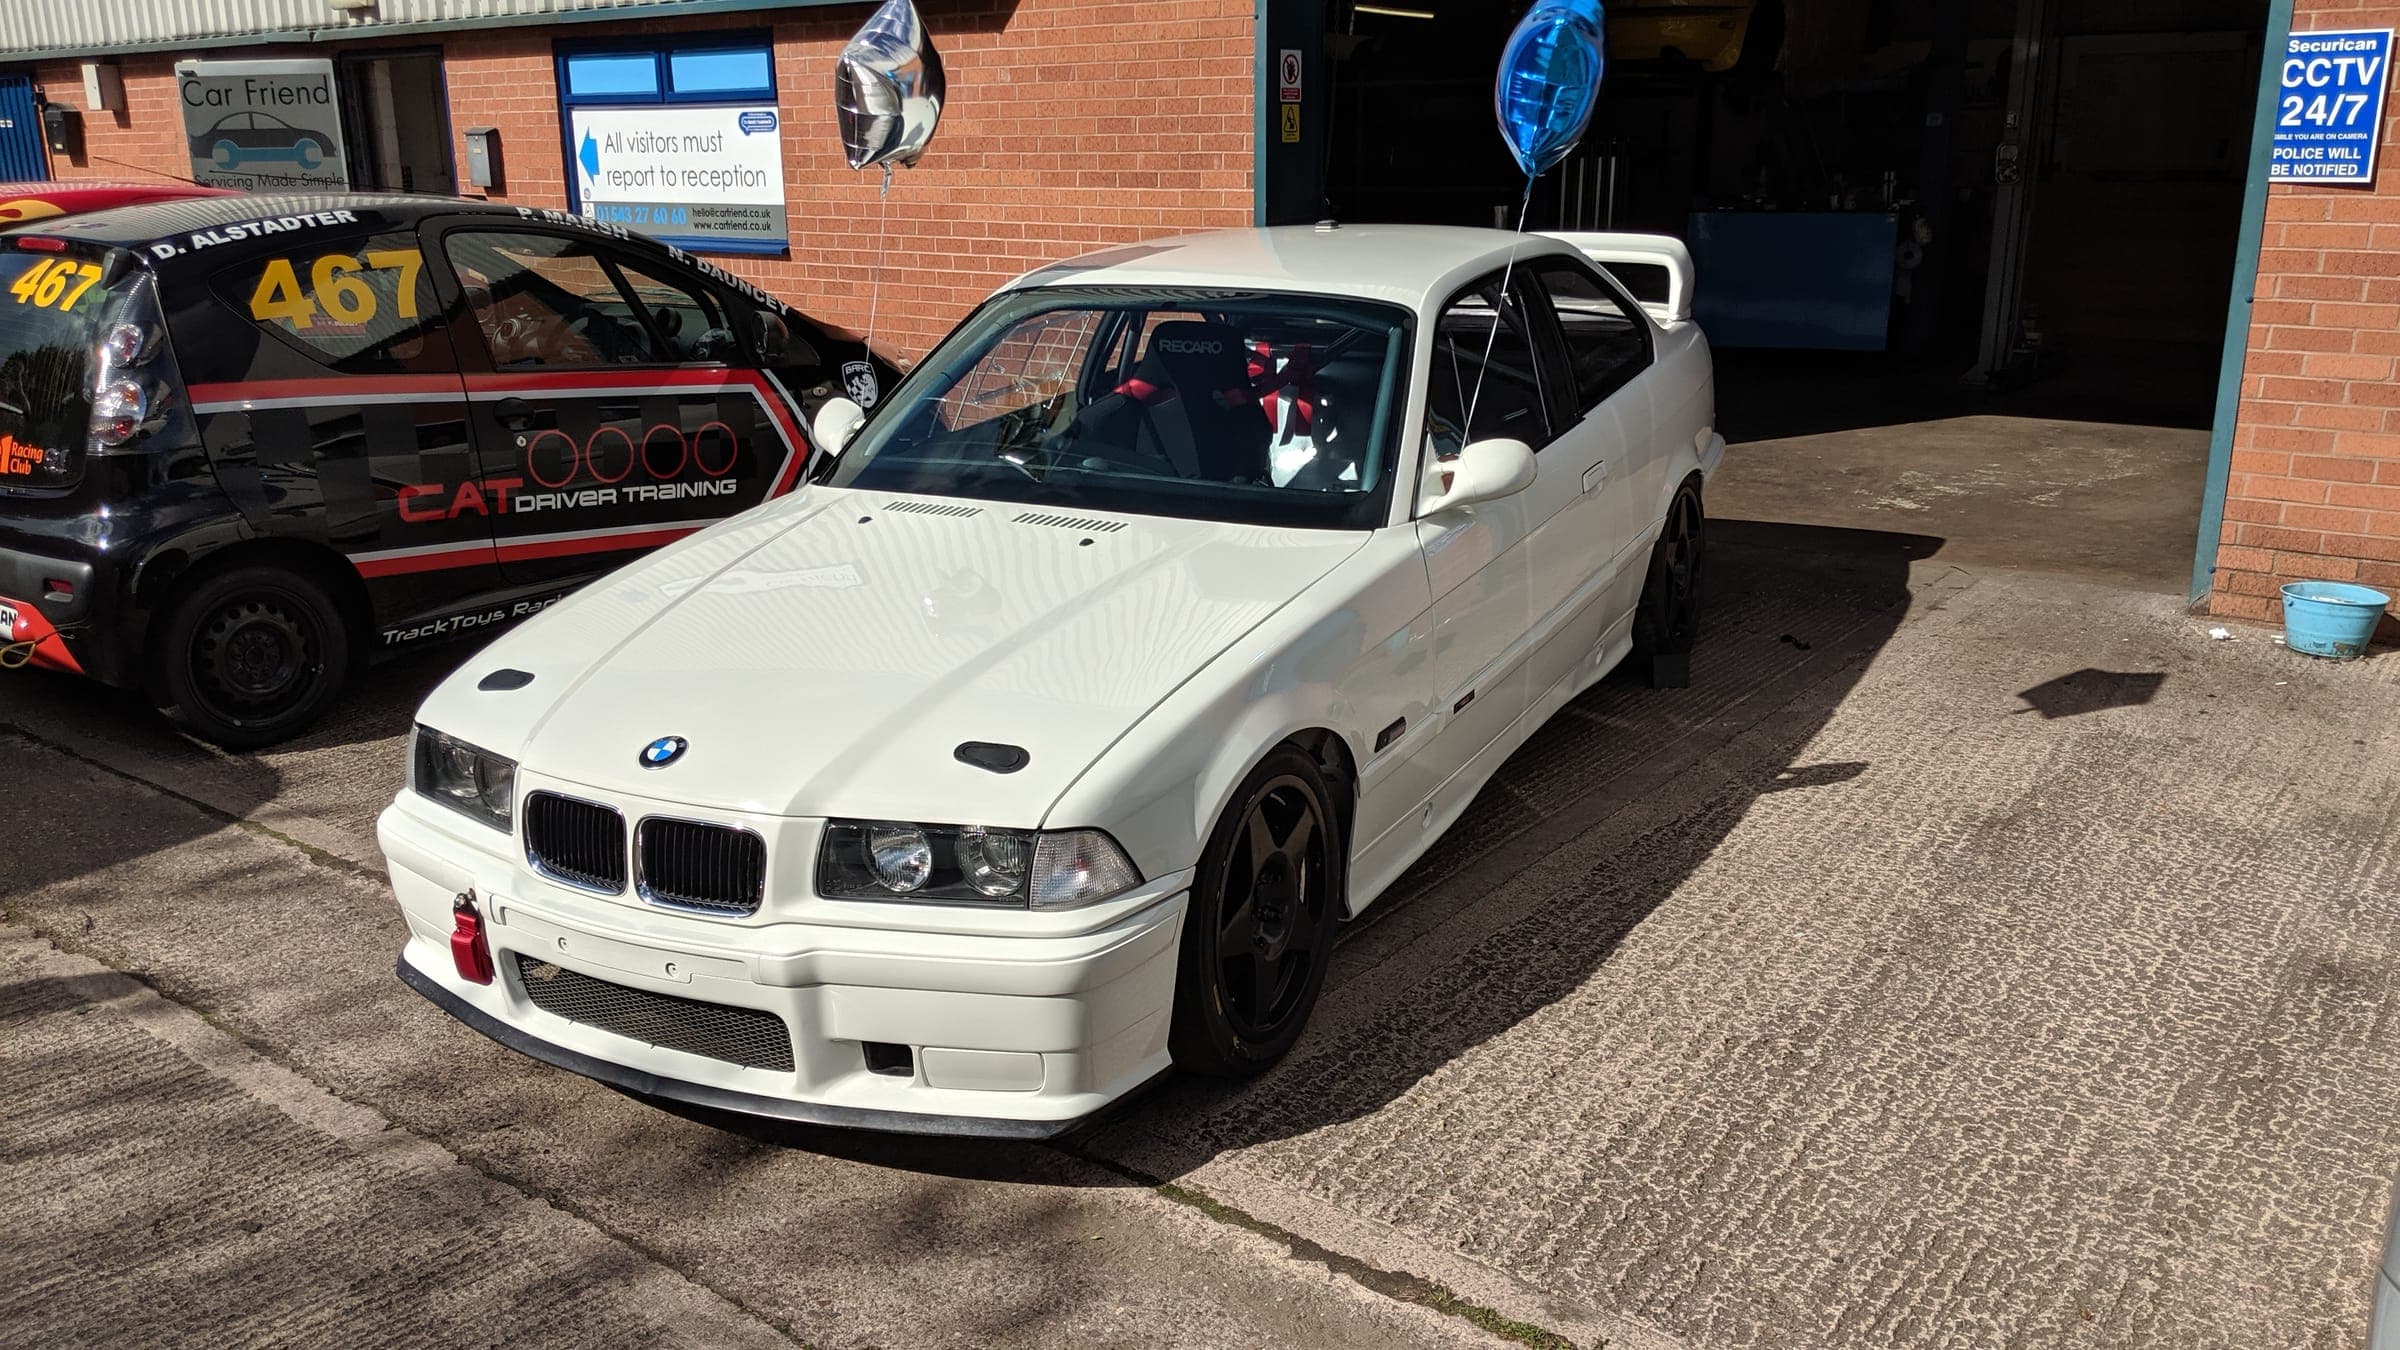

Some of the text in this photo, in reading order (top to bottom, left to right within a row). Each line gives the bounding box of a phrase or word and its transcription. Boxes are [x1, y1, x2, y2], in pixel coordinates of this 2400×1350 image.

[2288, 39, 2377, 53] Securican
[2282, 56, 2381, 87] CCTV
[183, 75, 330, 106] Car Friend
[2280, 94, 2368, 126] 24/7
[604, 130, 723, 153] All visitors must
[2273, 148, 2361, 159] POLICE WILL
[257, 175, 297, 188] Made
[302, 173, 344, 190] Simple
[607, 164, 767, 192] report to reception
[2271, 164, 2358, 175] BE NOTIFIED
[516, 207, 630, 241] P. MARSH
[636, 208, 649, 224] 27
[653, 208, 668, 224] 60
[671, 208, 687, 224] 60
[694, 221, 772, 232] www.carfriend.co.uk
[151, 210, 358, 260] D. ALSTADTER
[9, 258, 103, 313] 467
[248, 248, 424, 331] 467
[668, 245, 789, 316] N. DAUNCEY
[1159, 339, 1223, 354] RECARO
[0, 435, 13, 474] 1
[10, 458, 31, 475] Club
[11, 441, 44, 464] Racing
[397, 477, 523, 522] CAT
